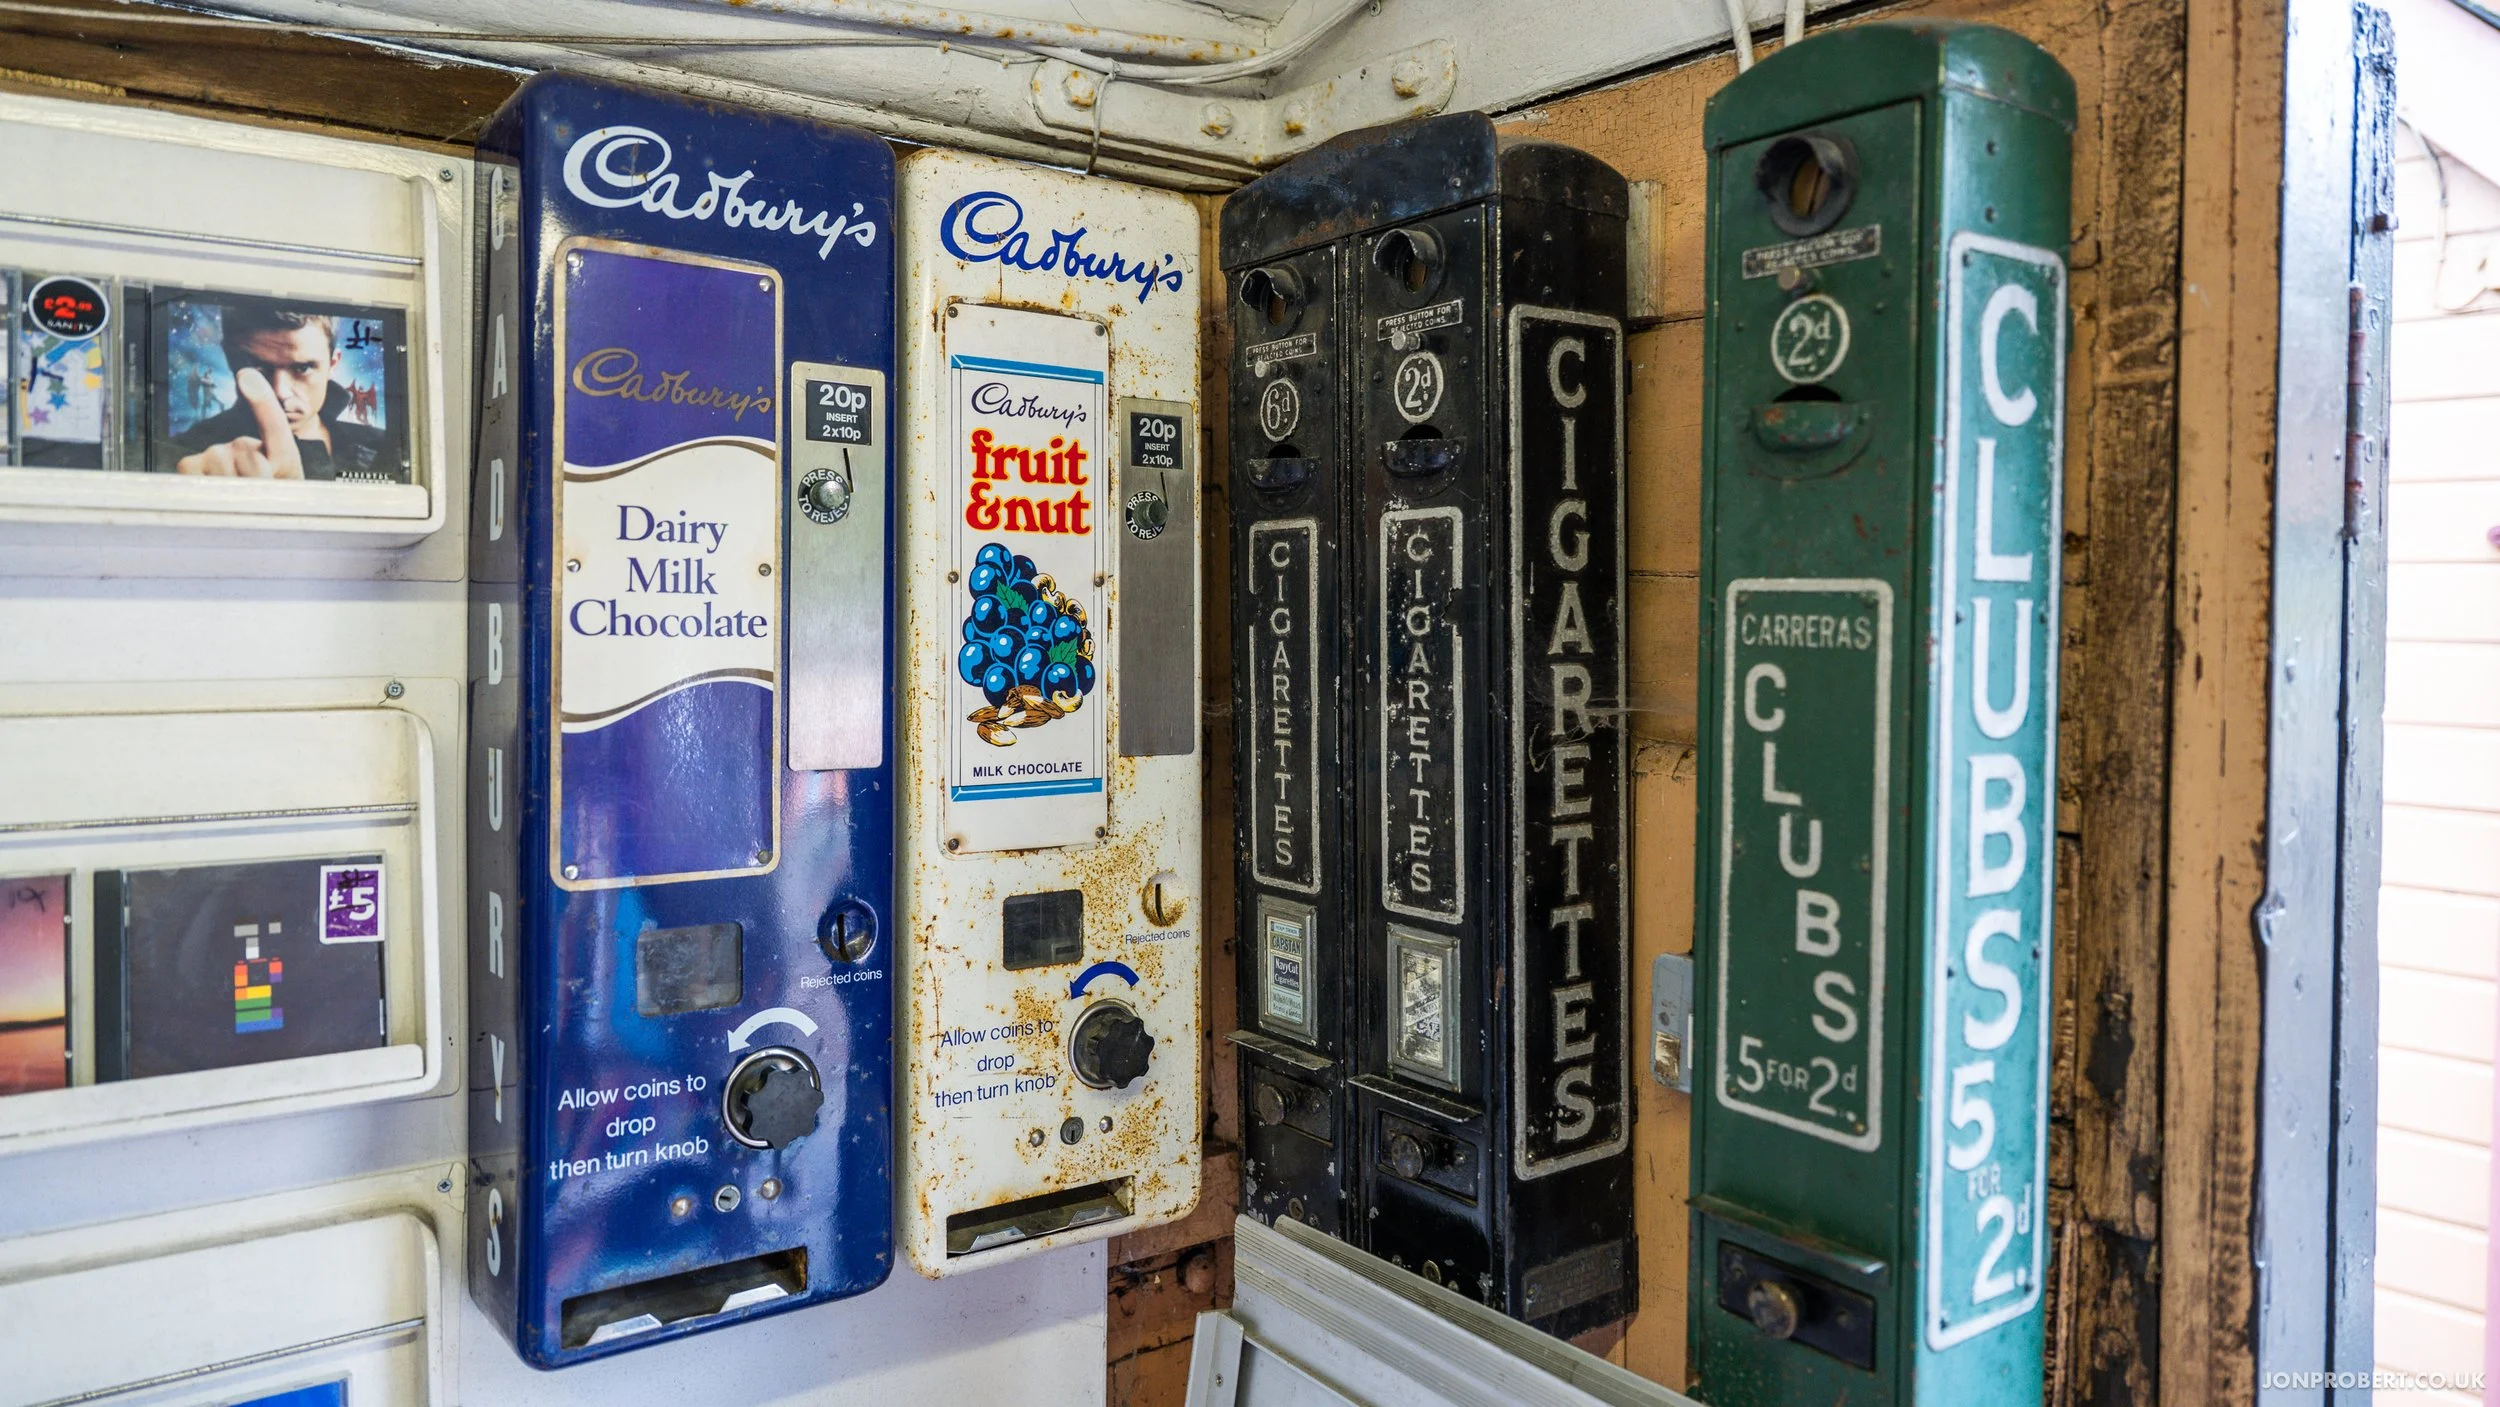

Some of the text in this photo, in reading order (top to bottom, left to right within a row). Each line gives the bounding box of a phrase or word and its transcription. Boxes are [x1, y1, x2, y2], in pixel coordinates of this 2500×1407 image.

[563, 125, 877, 260] Cadbury's
[940, 191, 1183, 304] Cadbury's
[1386, 306, 1451, 326] PRESS BUTTON FOR
[1272, 341, 1292, 350] BUTTON
[1295, 337, 1307, 346] FOR
[1788, 310, 1831, 367] 2d
[573, 348, 774, 422] Cadbury's
[819, 384, 866, 412] 20p
[1405, 367, 1431, 408] 2d
[826, 412, 858, 424] INSERT
[971, 382, 1088, 428] Cadbury's
[1266, 388, 1291, 429] 6d
[822, 425, 861, 441] 2x10p
[1139, 418, 1176, 442] 20p
[1144, 442, 1170, 452] INSERT
[969, 427, 1090, 487] fruit
[1142, 454, 1173, 467] 2x10p
[965, 478, 1092, 535] &nut
[616, 505, 728, 554] Dairy
[625, 557, 718, 594] Milk
[569, 599, 768, 638] Chocolate
[1741, 614, 1872, 650] CARRERAS
[1963, 283, 2038, 1051] CLUBS
[1269, 541, 1293, 867] CIGARETTES
[1405, 532, 1432, 892] CIGARETTES
[1547, 335, 1596, 1144] CIGARETTES
[972, 762, 1083, 777] MILK CHOCOLATE
[1744, 663, 1857, 1042] CLUBS
[328, 887, 376, 920] £5
[1125, 928, 1191, 946] Rejected coins
[800, 968, 883, 989] Rejected coins
[940, 1017, 1054, 1049] Allow coins to
[977, 1052, 1016, 1074] drop
[1737, 1035, 1765, 1093] 5
[1766, 1059, 1810, 1091] FOR
[557, 1074, 707, 1111] Allow coins to
[934, 1072, 1056, 1109] then turn knob
[605, 1115, 656, 1138] drop
[1947, 1059, 1995, 1170] 5
[550, 1136, 709, 1180] then turn knob
